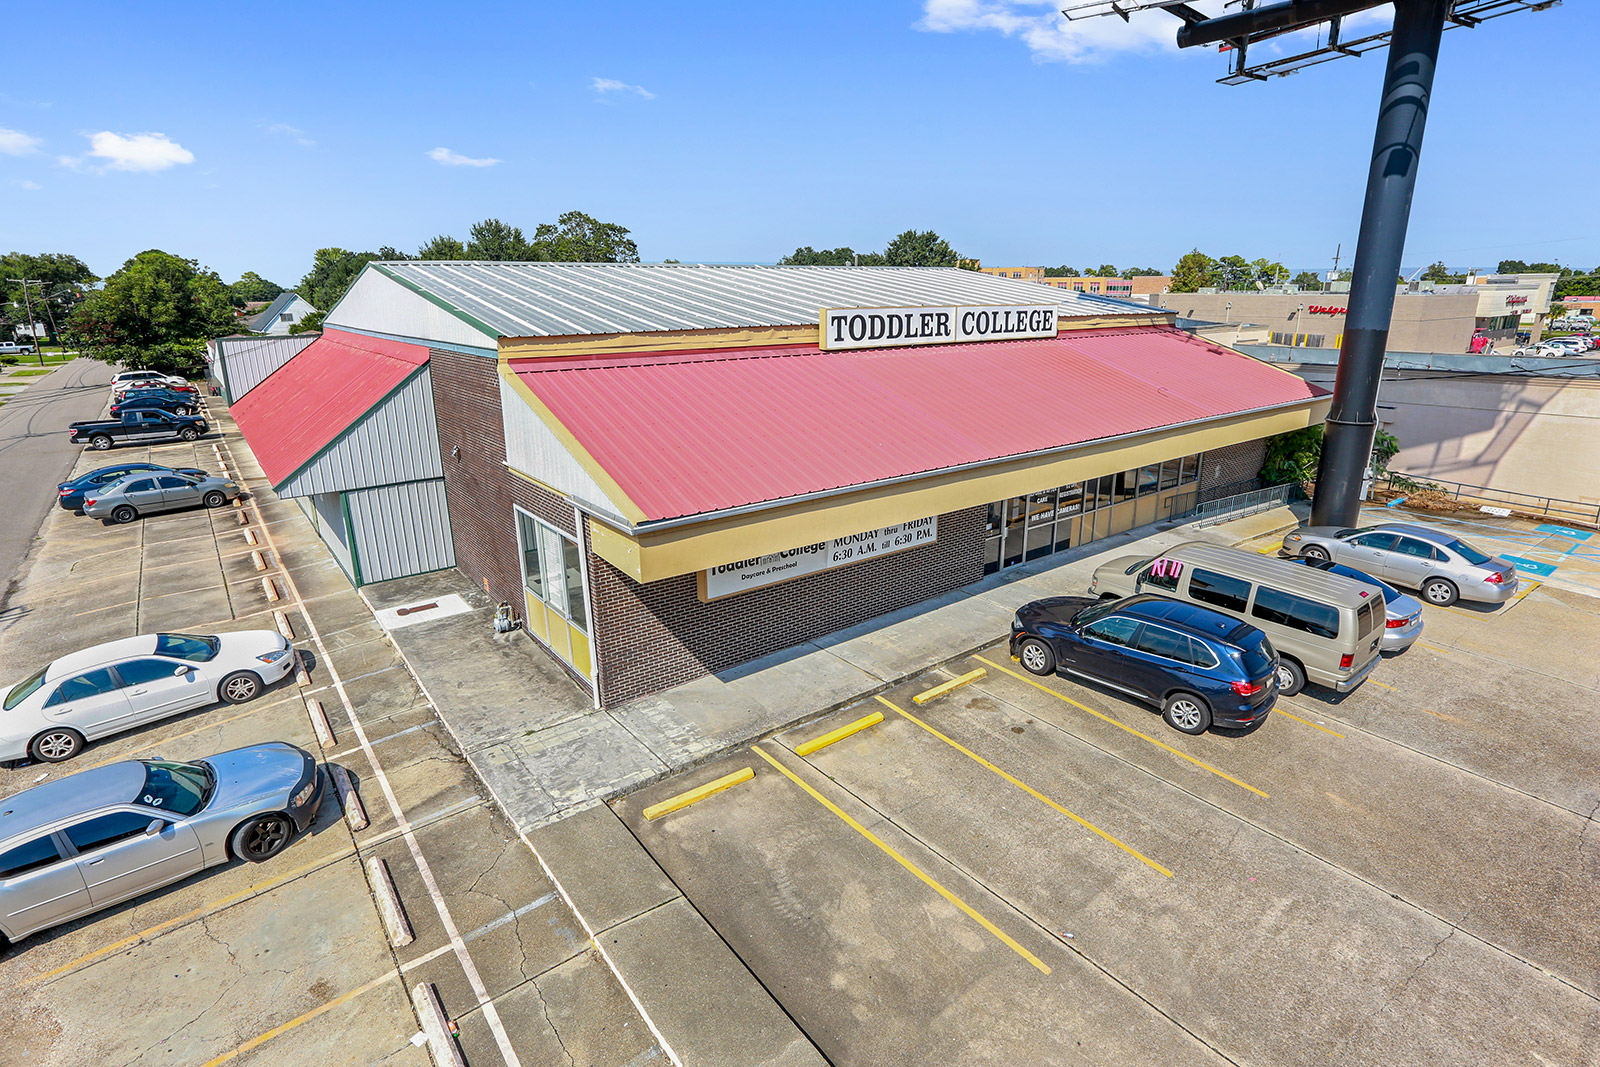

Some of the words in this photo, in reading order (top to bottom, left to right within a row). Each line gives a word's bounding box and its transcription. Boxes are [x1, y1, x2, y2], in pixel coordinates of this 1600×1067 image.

[831, 312, 951, 342] TODDLER
[961, 310, 1054, 336] COLLEGE
[1031, 513, 1039, 521] WE
[1040, 510, 1054, 519] HAVE
[832, 548, 853, 562] 6:30
[857, 542, 877, 556] A.M.
[881, 540, 891, 549] till
[894, 532, 913, 546] 6:30
[833, 529, 879, 548] MONDAY
[884, 527, 898, 536] thru
[903, 516, 934, 531] FRIDAY
[741, 569, 765, 580] Daycare
[772, 561, 798, 573] Preschool
